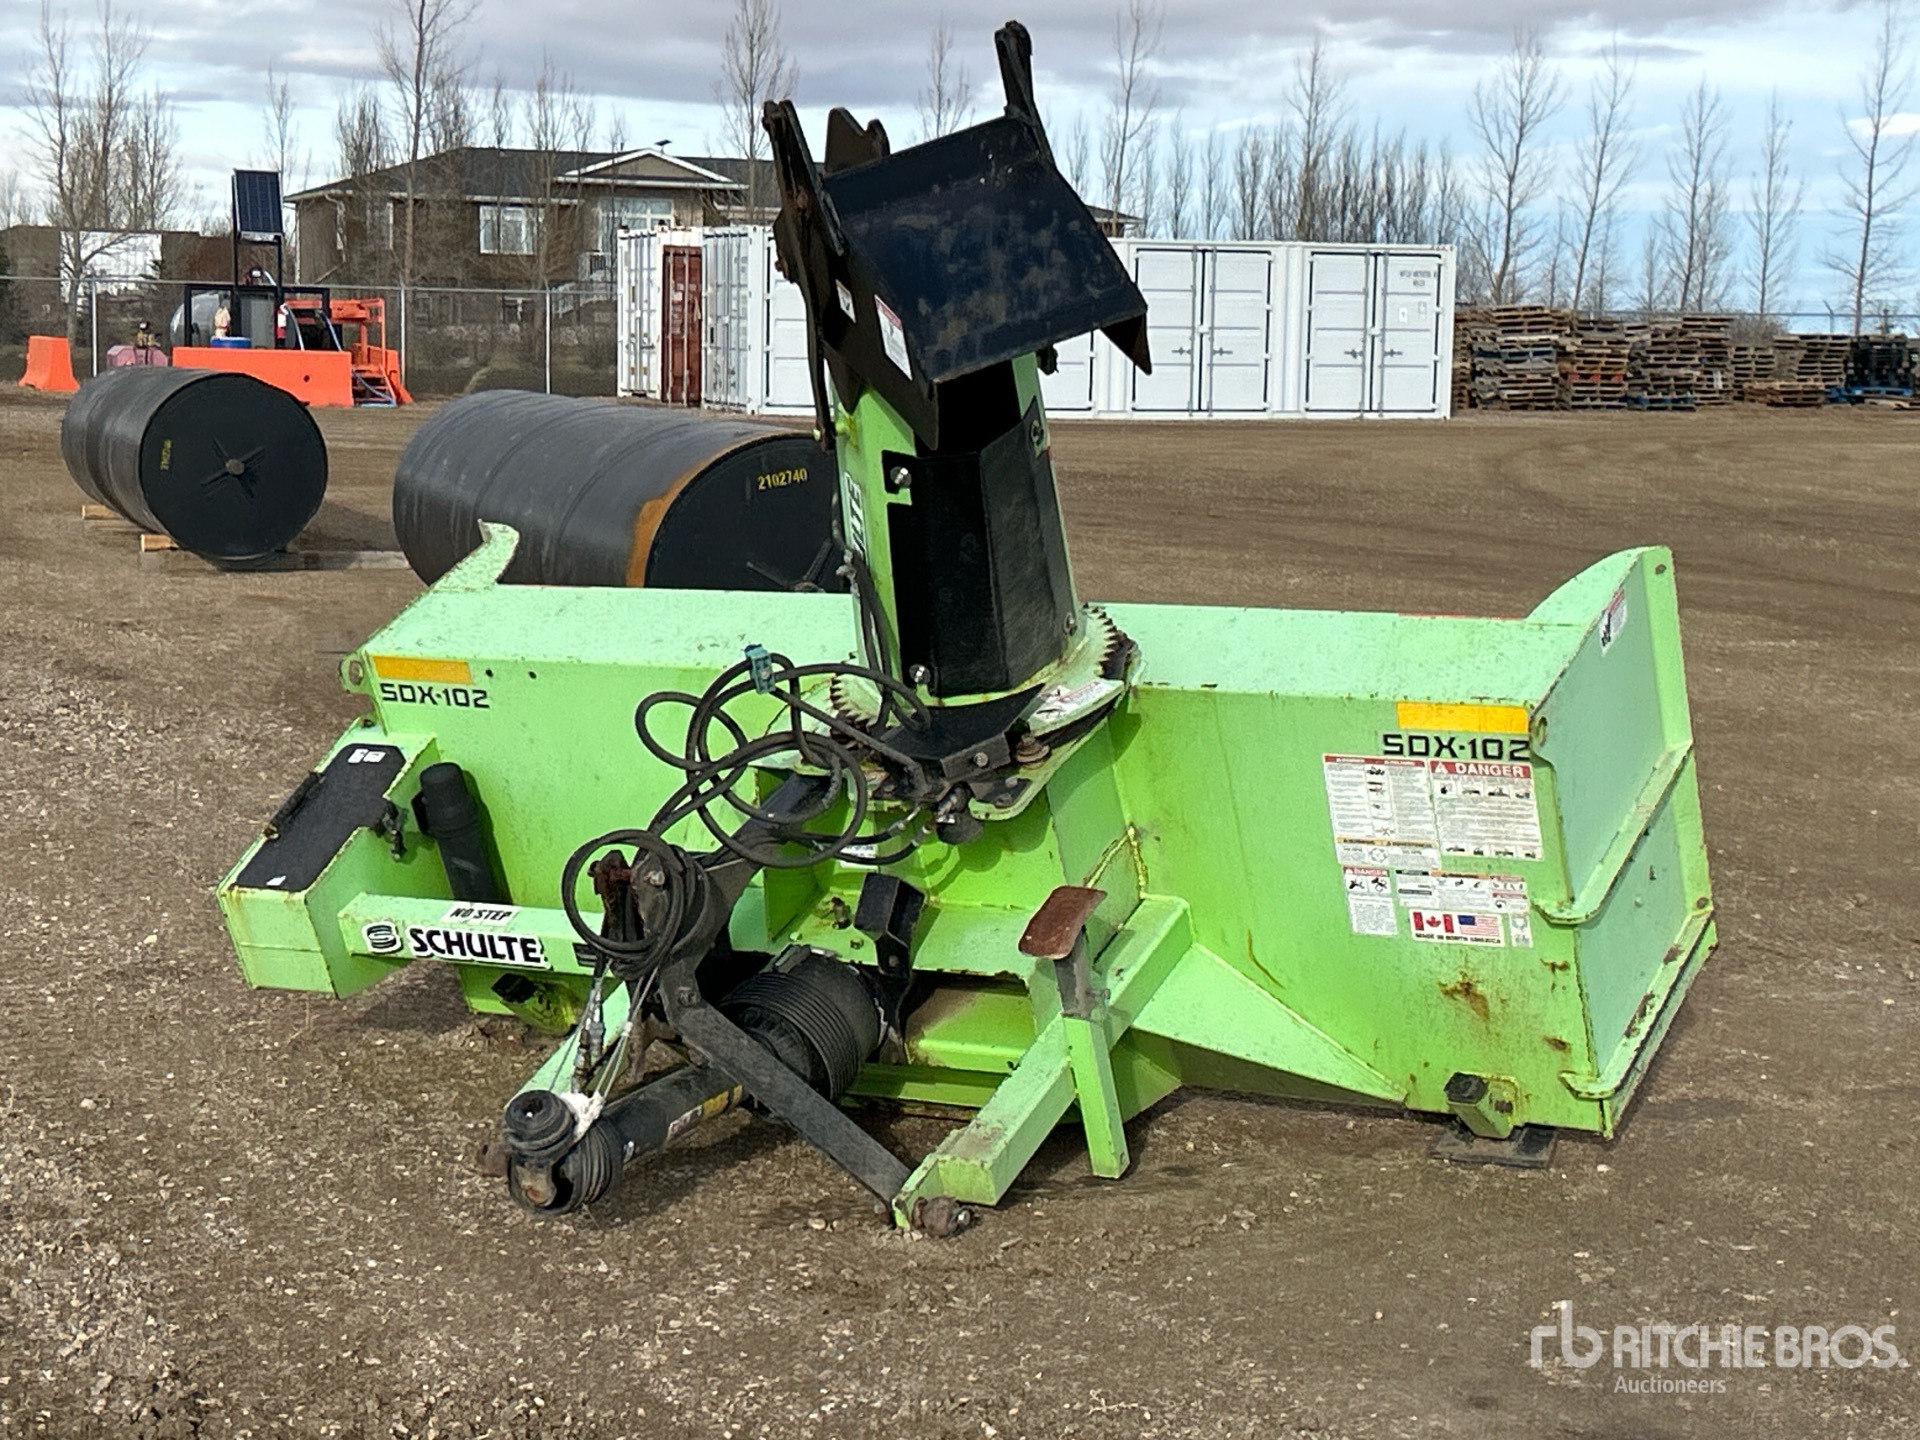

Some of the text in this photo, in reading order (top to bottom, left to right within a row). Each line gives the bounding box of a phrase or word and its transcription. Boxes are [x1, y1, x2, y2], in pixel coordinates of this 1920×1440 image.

[757, 468, 808, 490] 2102740
[1454, 761, 1525, 778] DANGER
[450, 907, 513, 921] NO STEP
[408, 927, 542, 963] SCHULTE
